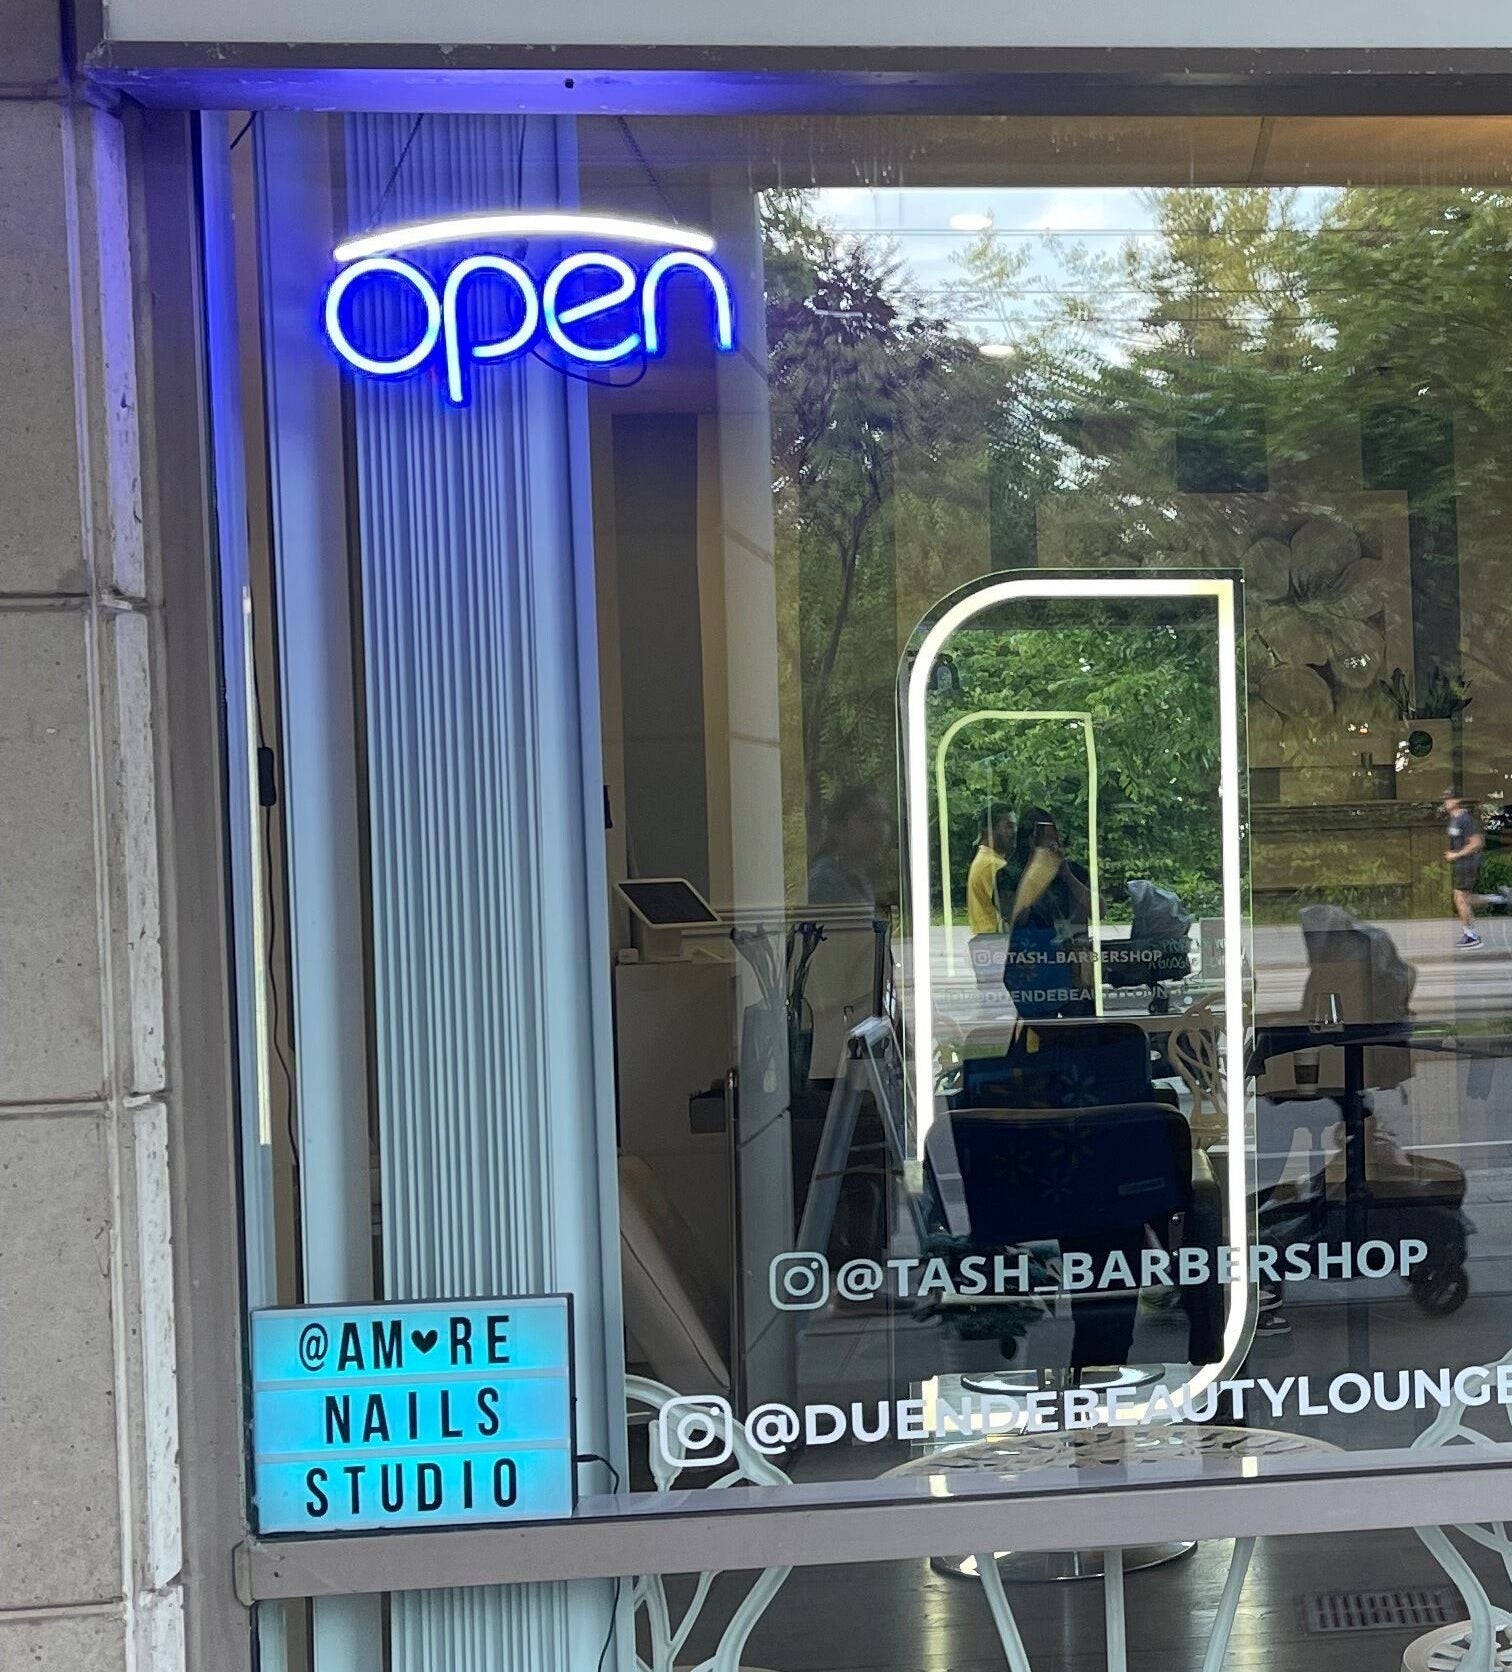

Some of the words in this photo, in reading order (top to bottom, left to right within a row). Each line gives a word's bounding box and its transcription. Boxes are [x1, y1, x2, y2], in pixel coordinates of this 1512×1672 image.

[324, 250, 734, 404] open
[836, 1239, 1428, 1301] @TASH_BARBERSHOP
[325, 1387, 499, 1445] NAILS
[306, 1458, 518, 1518] STUDIO
